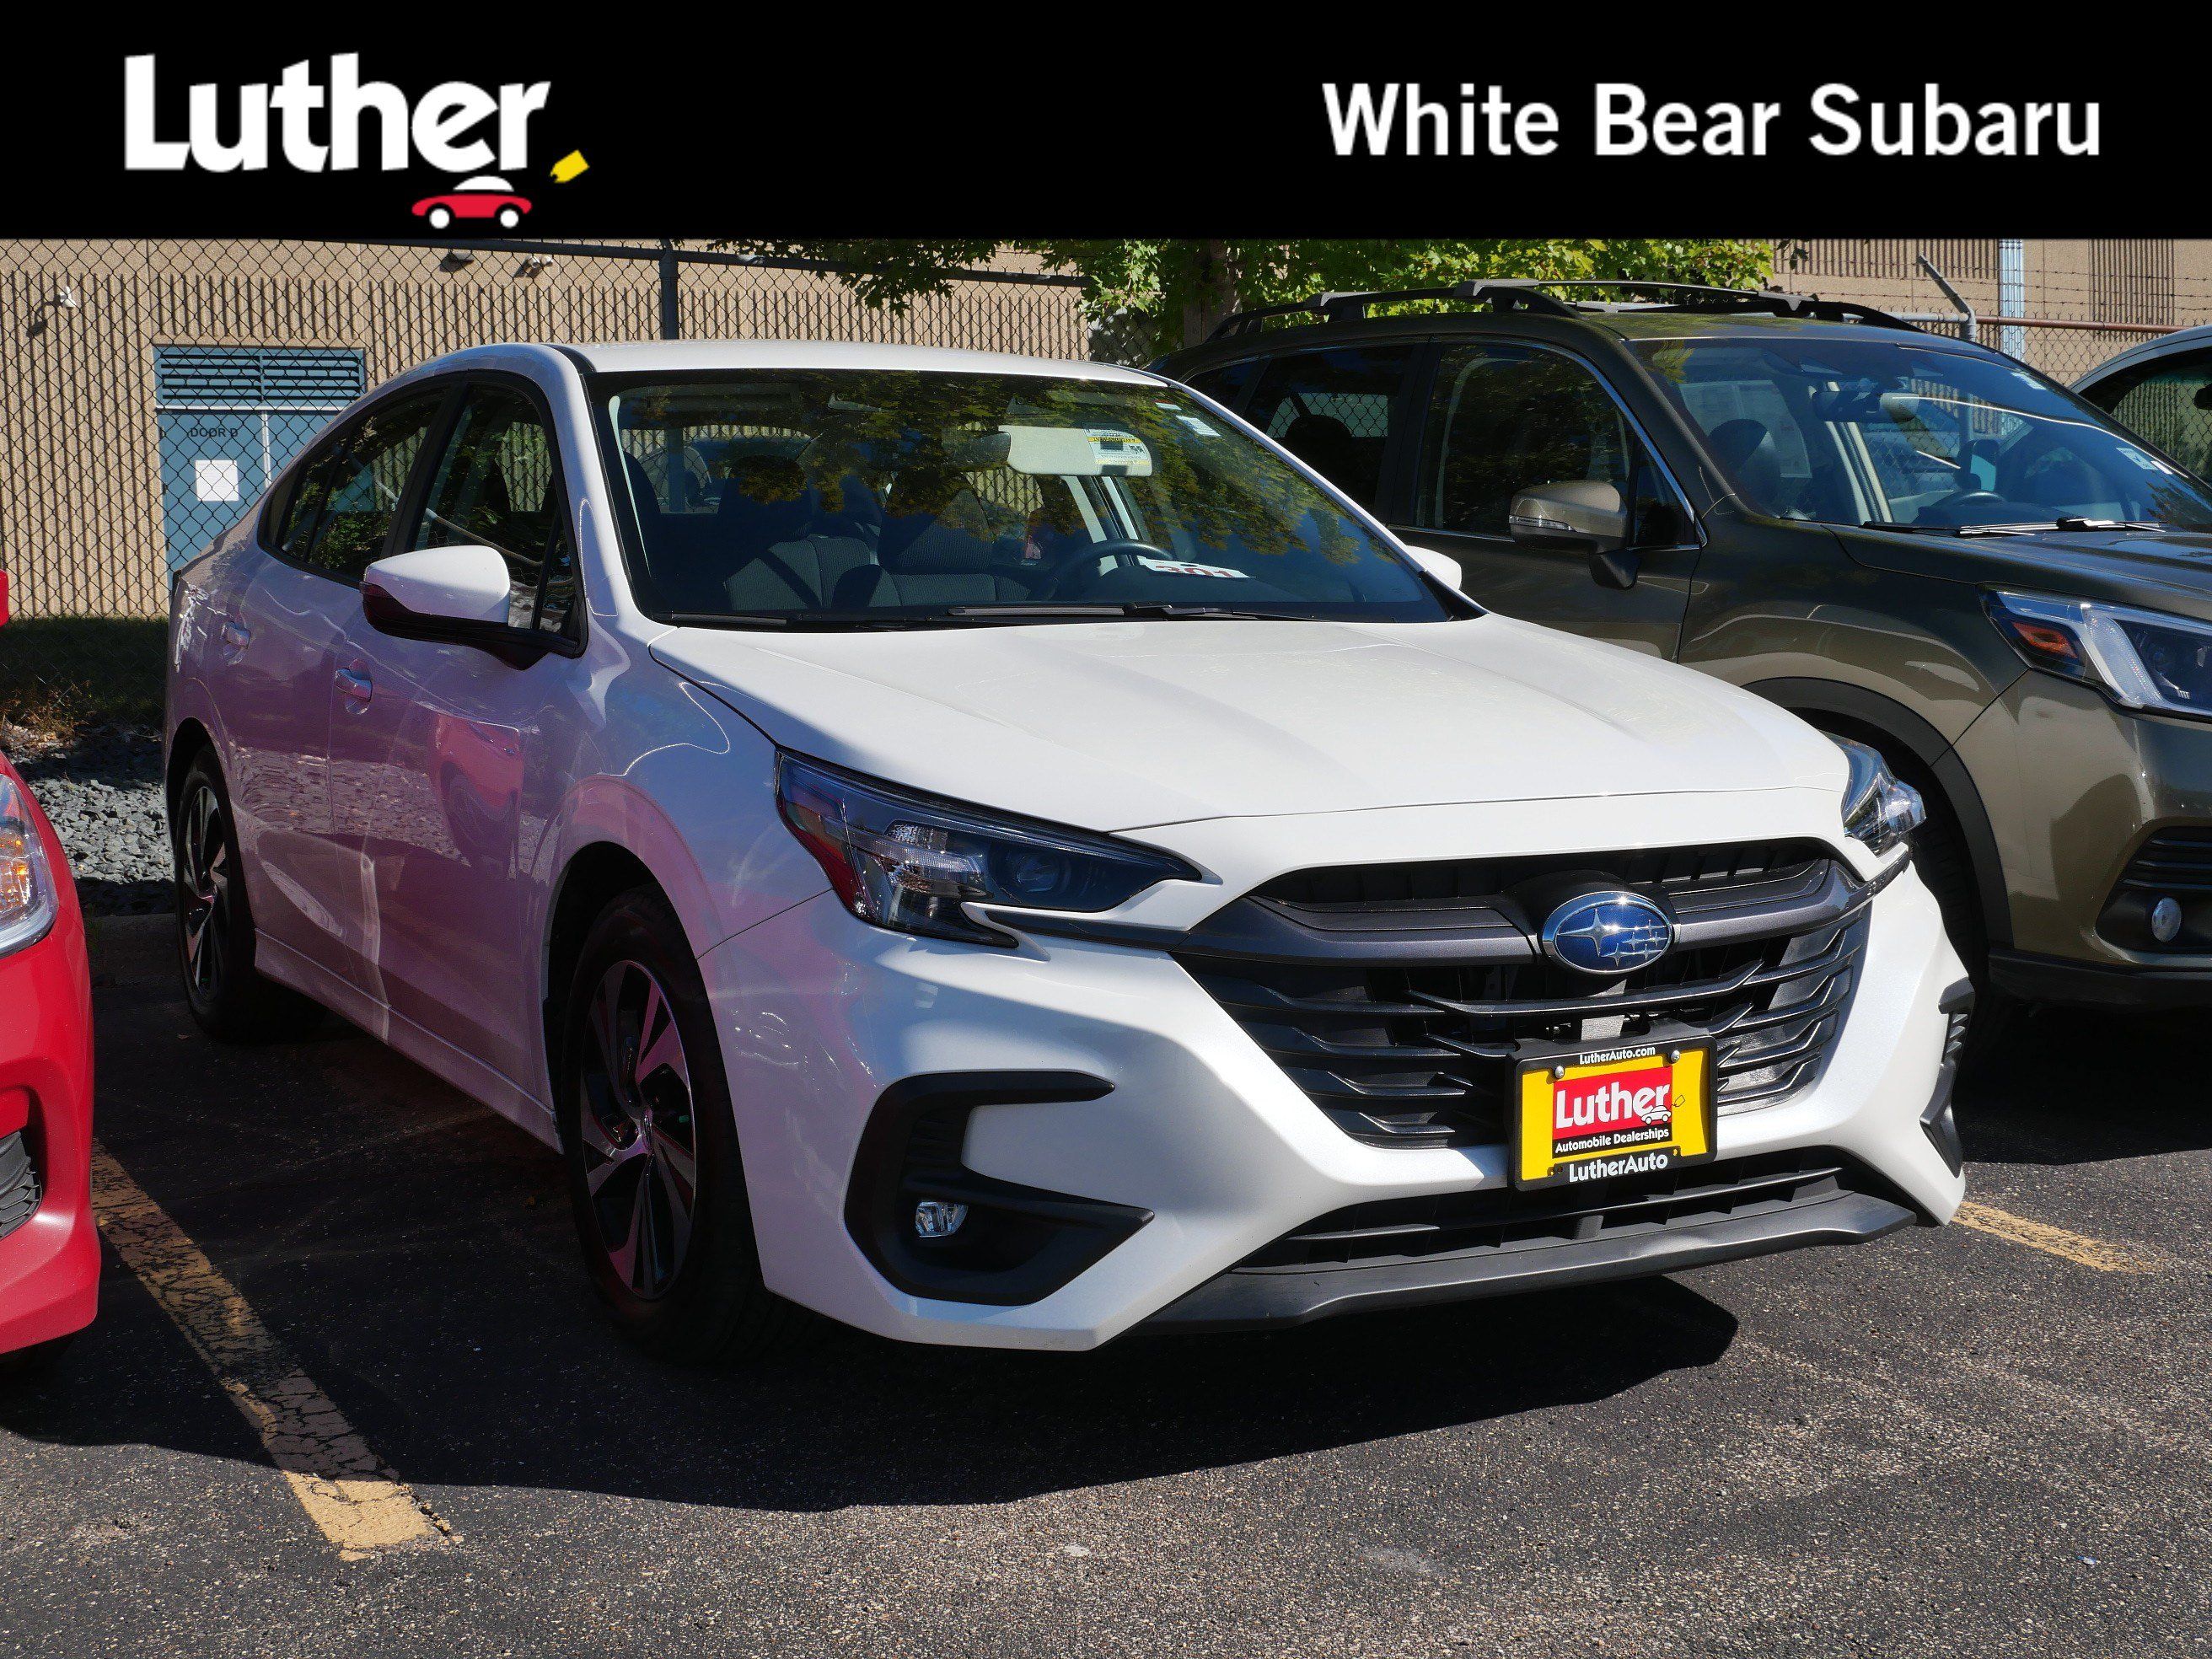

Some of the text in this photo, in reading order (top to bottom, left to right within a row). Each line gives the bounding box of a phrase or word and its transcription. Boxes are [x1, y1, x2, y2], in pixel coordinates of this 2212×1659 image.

[191, 427, 226, 438] DOOR
[1579, 1046, 1656, 1066] LutherAuto.com
[1555, 1082, 1671, 1129] Luther
[1555, 1127, 1669, 1154] Automobile Dealerships
[1569, 1152, 1668, 1183] LutherAuto
